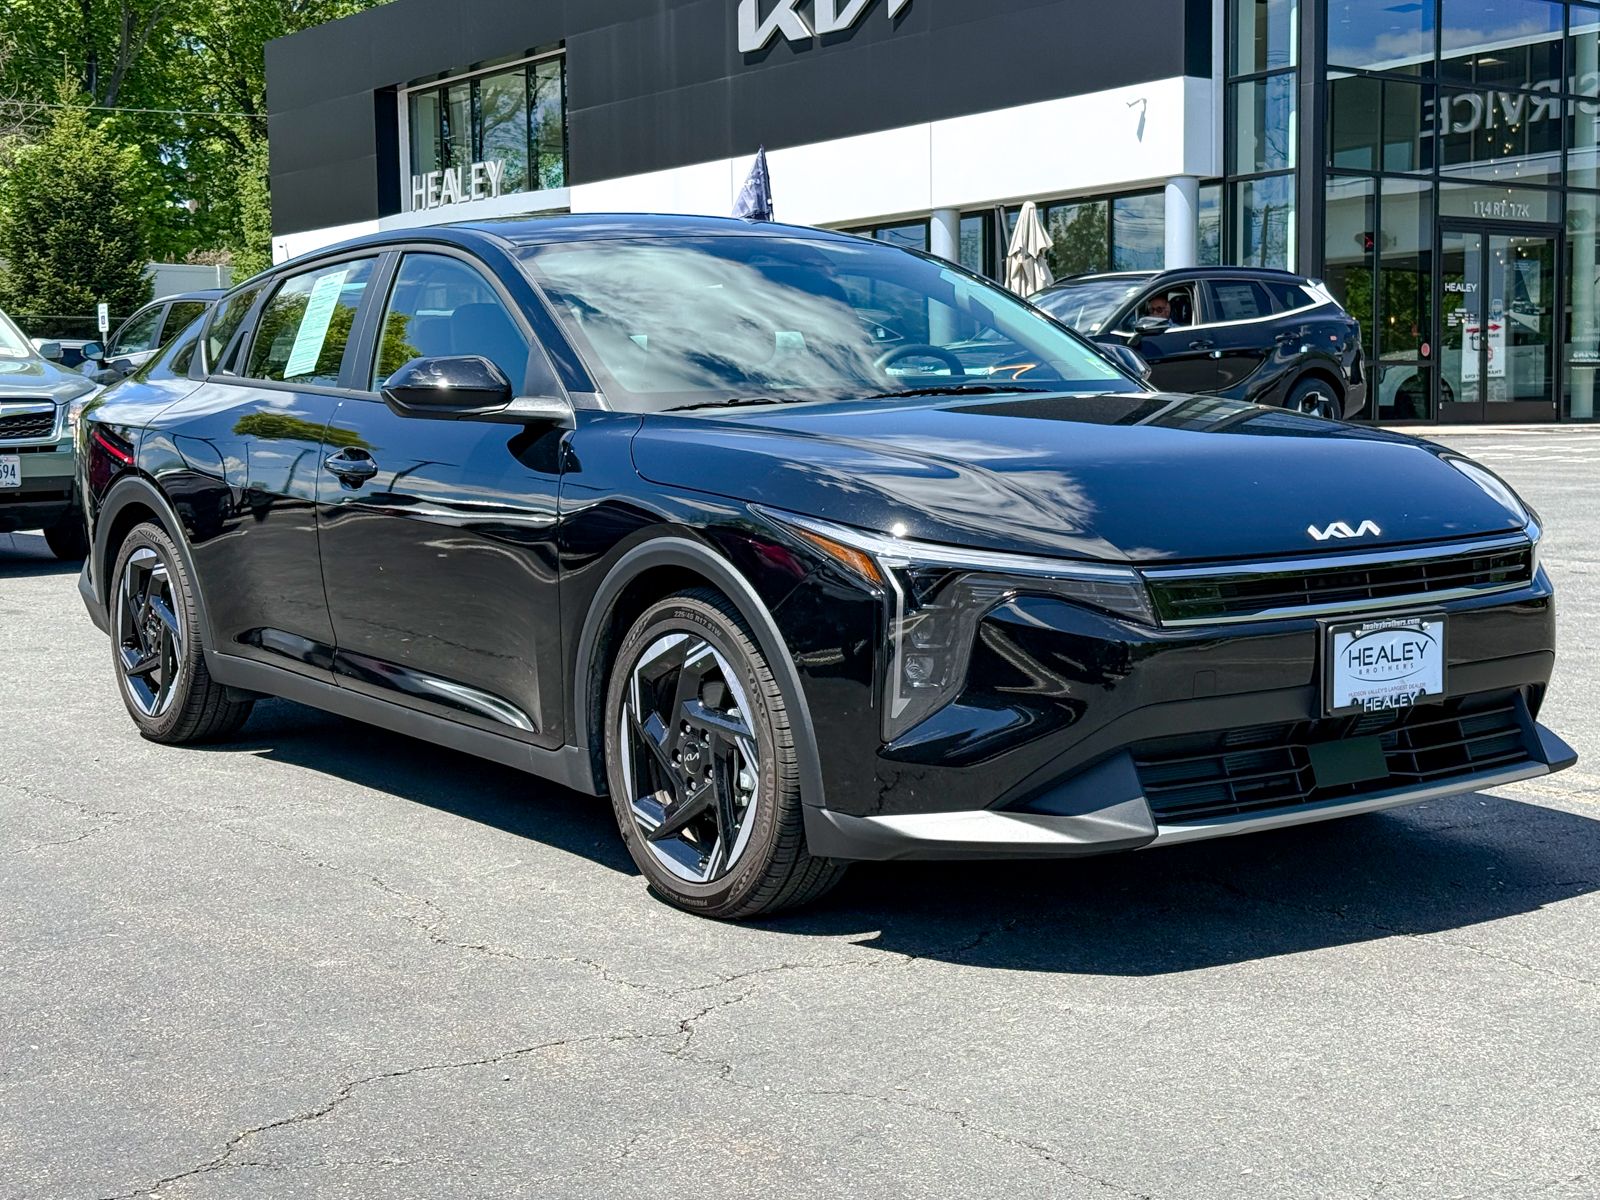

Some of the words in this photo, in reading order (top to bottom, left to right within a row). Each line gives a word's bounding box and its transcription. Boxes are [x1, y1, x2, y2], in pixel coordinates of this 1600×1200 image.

[738, 0, 909, 53] KI
[412, 159, 505, 212] HEALEY
[1473, 201, 1492, 217] 114
[1510, 204, 1530, 218] 17K
[1444, 282, 1477, 292] HEALEY
[1307, 519, 1381, 541] KIA
[1362, 618, 1421, 630] healeybrothers.com
[1348, 640, 1429, 668] HEALEY
[1359, 662, 1415, 675] BROTHERS
[1362, 691, 1417, 713] HEALEY
[761, 757, 775, 836] KUMHO
